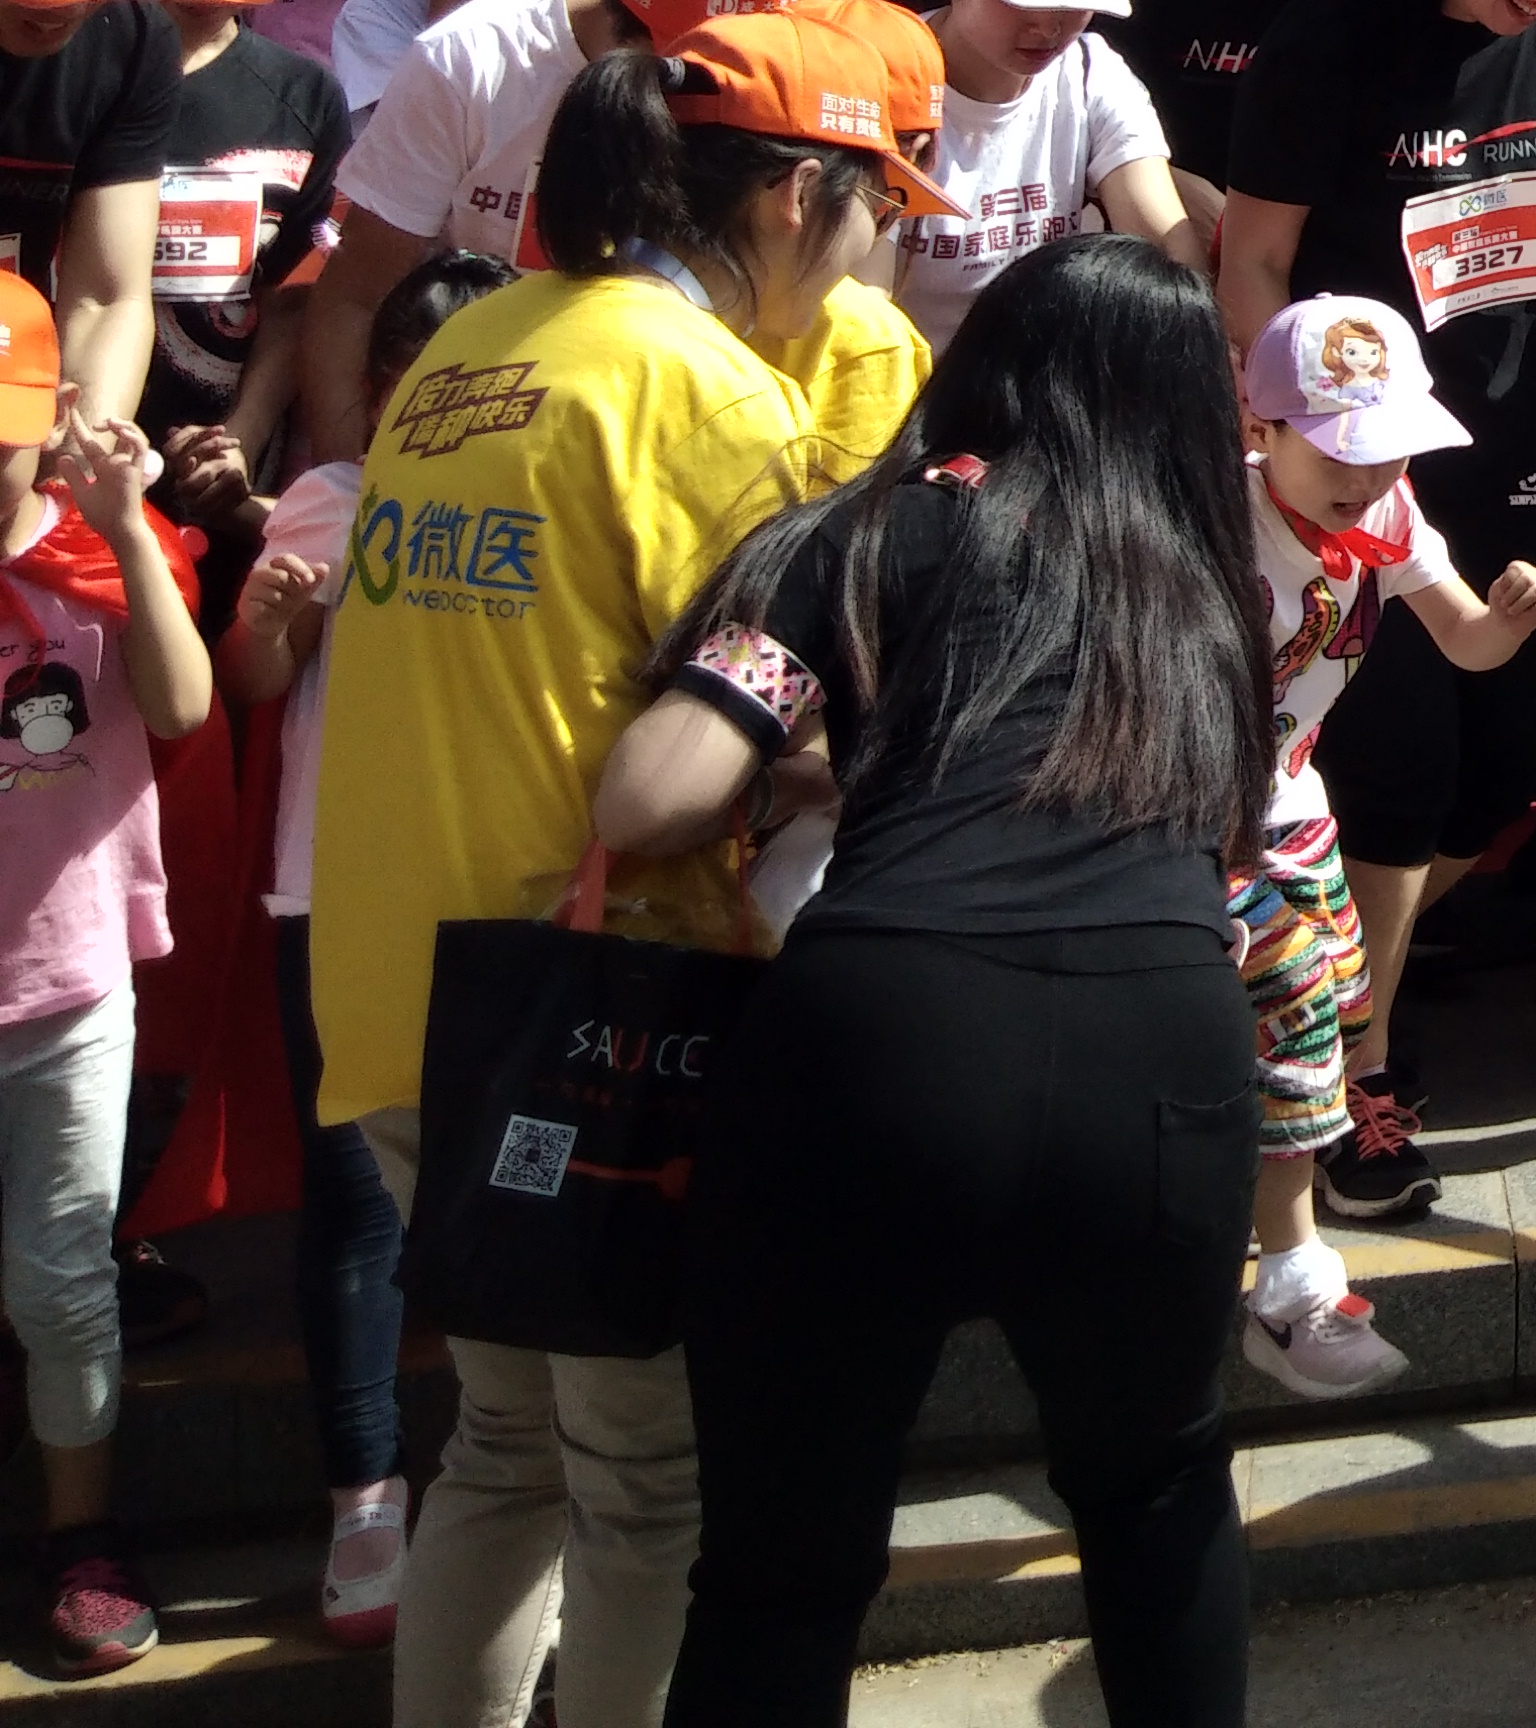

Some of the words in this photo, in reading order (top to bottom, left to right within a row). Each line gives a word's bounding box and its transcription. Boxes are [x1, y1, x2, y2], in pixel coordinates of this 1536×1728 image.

[821, 92, 881, 120] 面对生命
[821, 113, 882, 139] 只有责任
[1388, 128, 1468, 169] NHC
[980, 183, 1048, 222] 第三届
[1457, 245, 1524, 279] 3327
[407, 499, 547, 592] 微医
